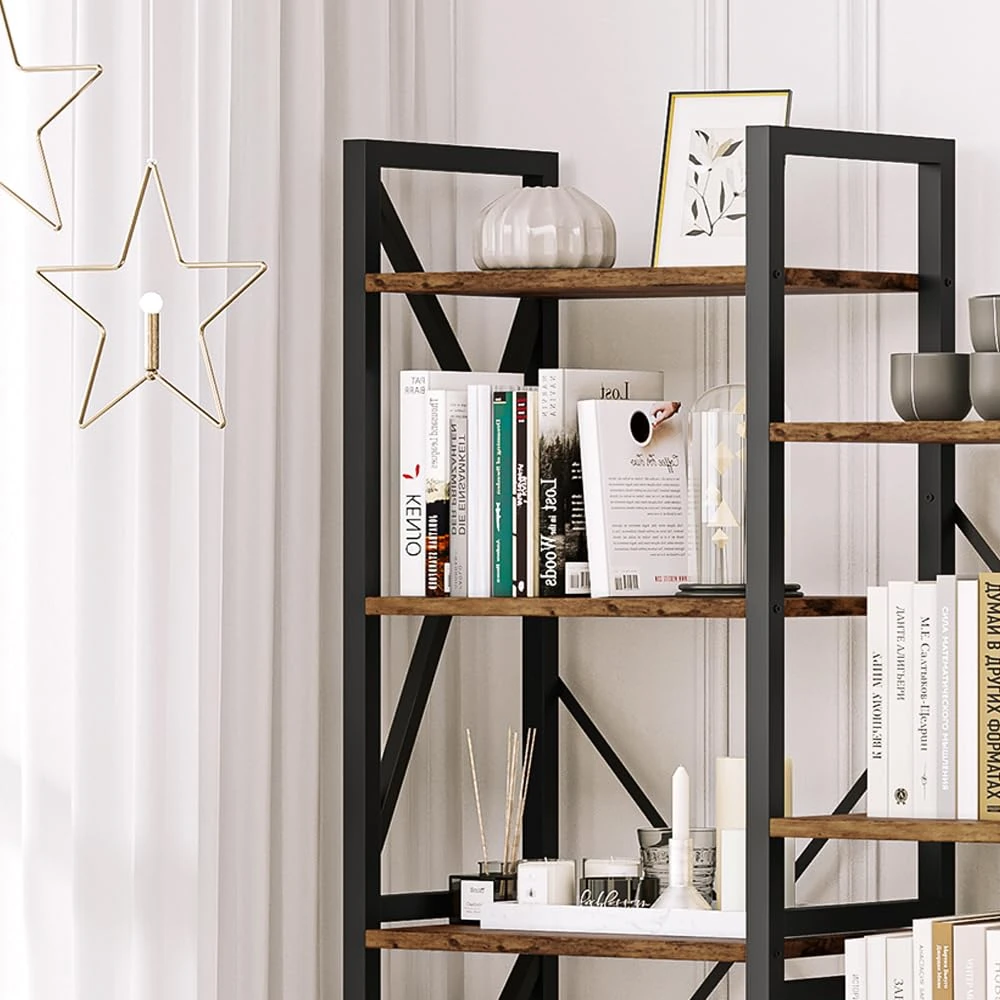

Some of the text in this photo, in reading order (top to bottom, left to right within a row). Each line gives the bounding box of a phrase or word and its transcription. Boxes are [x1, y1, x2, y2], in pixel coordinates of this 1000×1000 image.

[895, 606, 905, 701] ДАНТЕ АЛИГЬЕРИ
[941, 606, 949, 633] СИЛА
[917, 642, 931, 751] Салтыков-Щедрин
